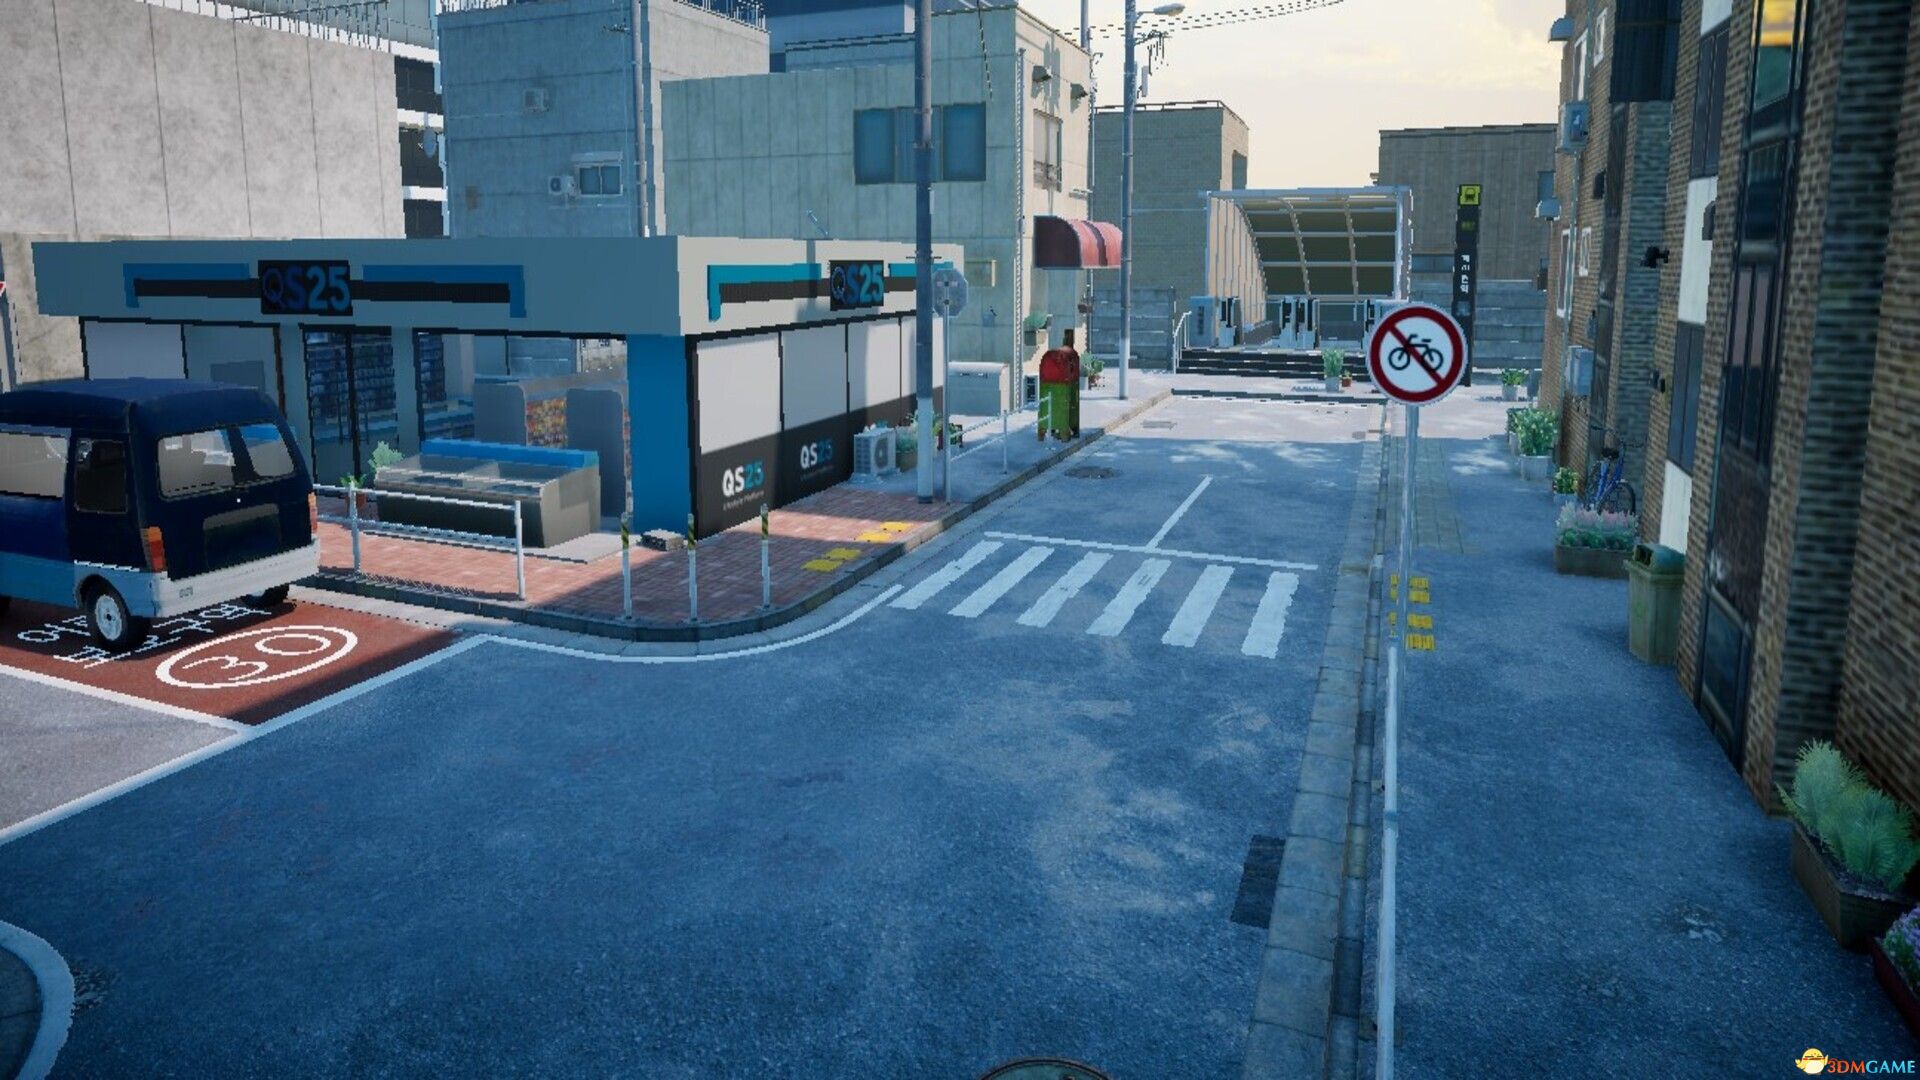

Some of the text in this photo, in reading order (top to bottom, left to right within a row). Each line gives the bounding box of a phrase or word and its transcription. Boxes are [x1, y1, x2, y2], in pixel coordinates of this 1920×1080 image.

[262, 264, 351, 312] QS25
[831, 263, 884, 305] QS25
[800, 438, 833, 469] QS25
[722, 459, 765, 497] QS25
[181, 632, 331, 682] 30
